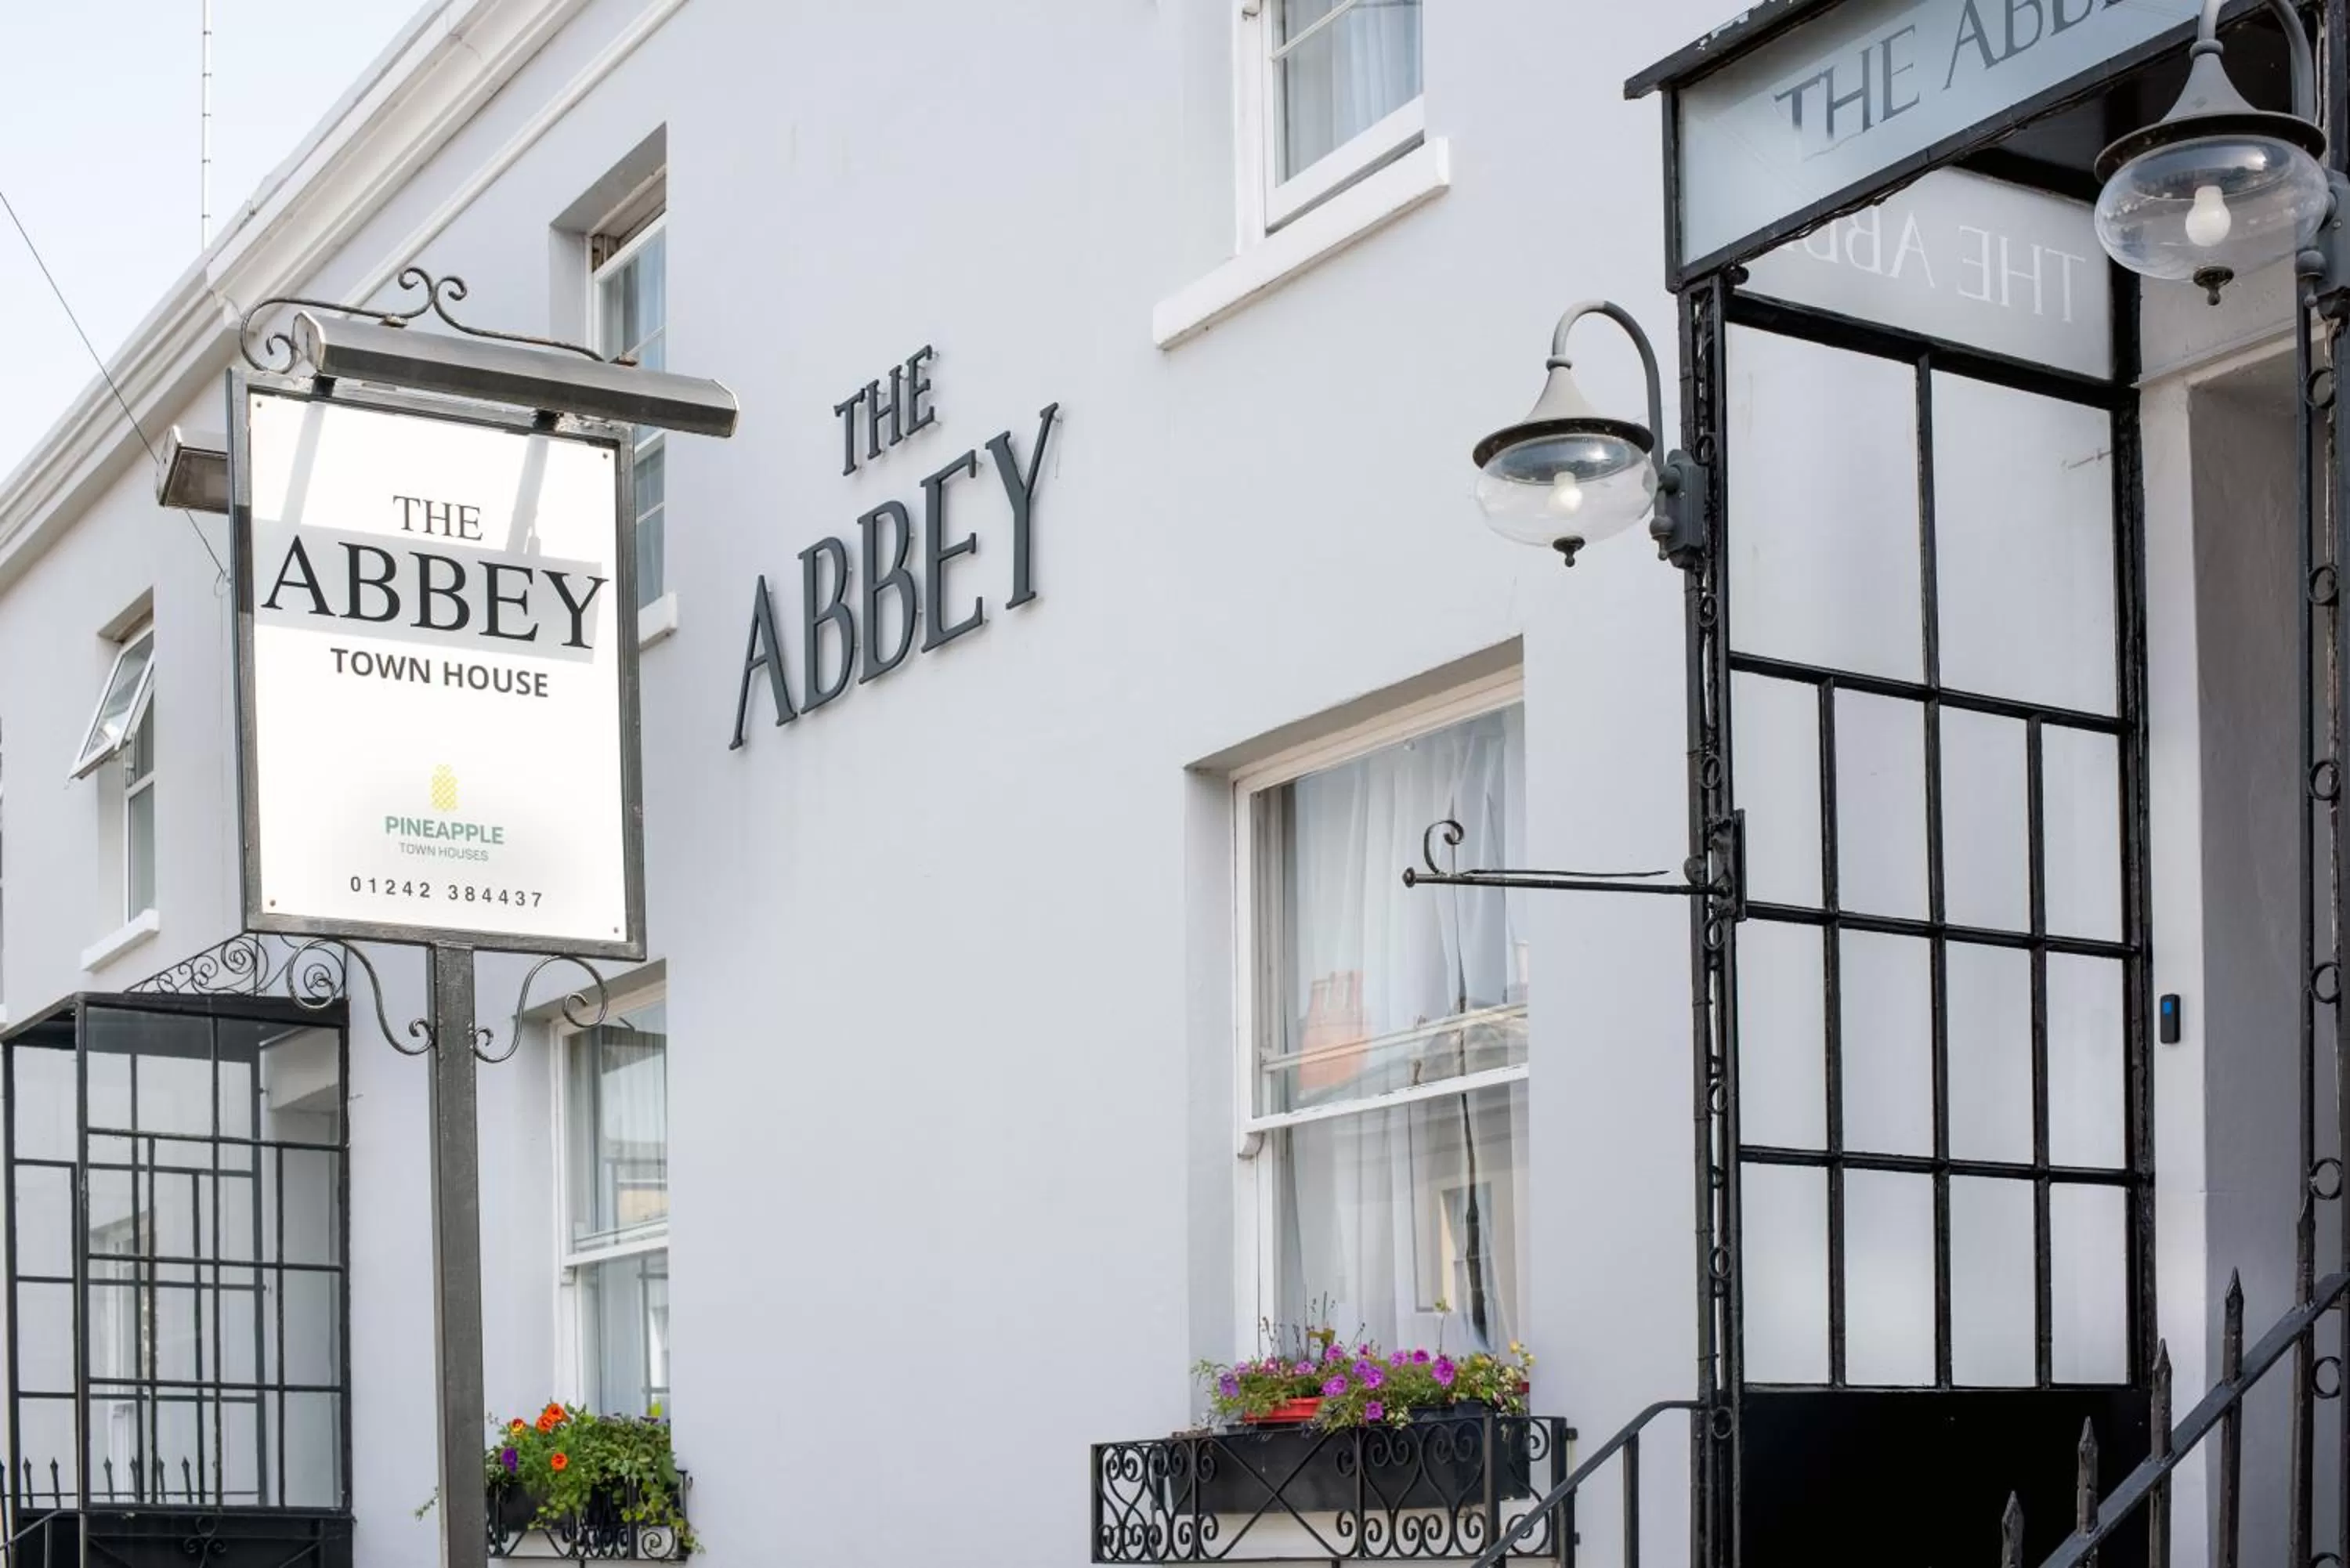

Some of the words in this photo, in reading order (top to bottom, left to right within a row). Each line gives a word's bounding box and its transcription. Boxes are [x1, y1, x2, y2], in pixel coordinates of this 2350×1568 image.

[1773, 24, 1920, 139] THE
[833, 345, 935, 476] THE
[393, 495, 483, 541] THE
[260, 534, 609, 649] ABBEY
[728, 402, 1059, 751] ABBEY
[330, 647, 431, 684] TOWN
[443, 661, 548, 698] HOUSE
[385, 815, 504, 844] PINEAPPLE
[399, 841, 436, 858] TOWN
[438, 845, 490, 862] HOUSES
[350, 876, 431, 898] 01242
[447, 884, 542, 908] 384437
